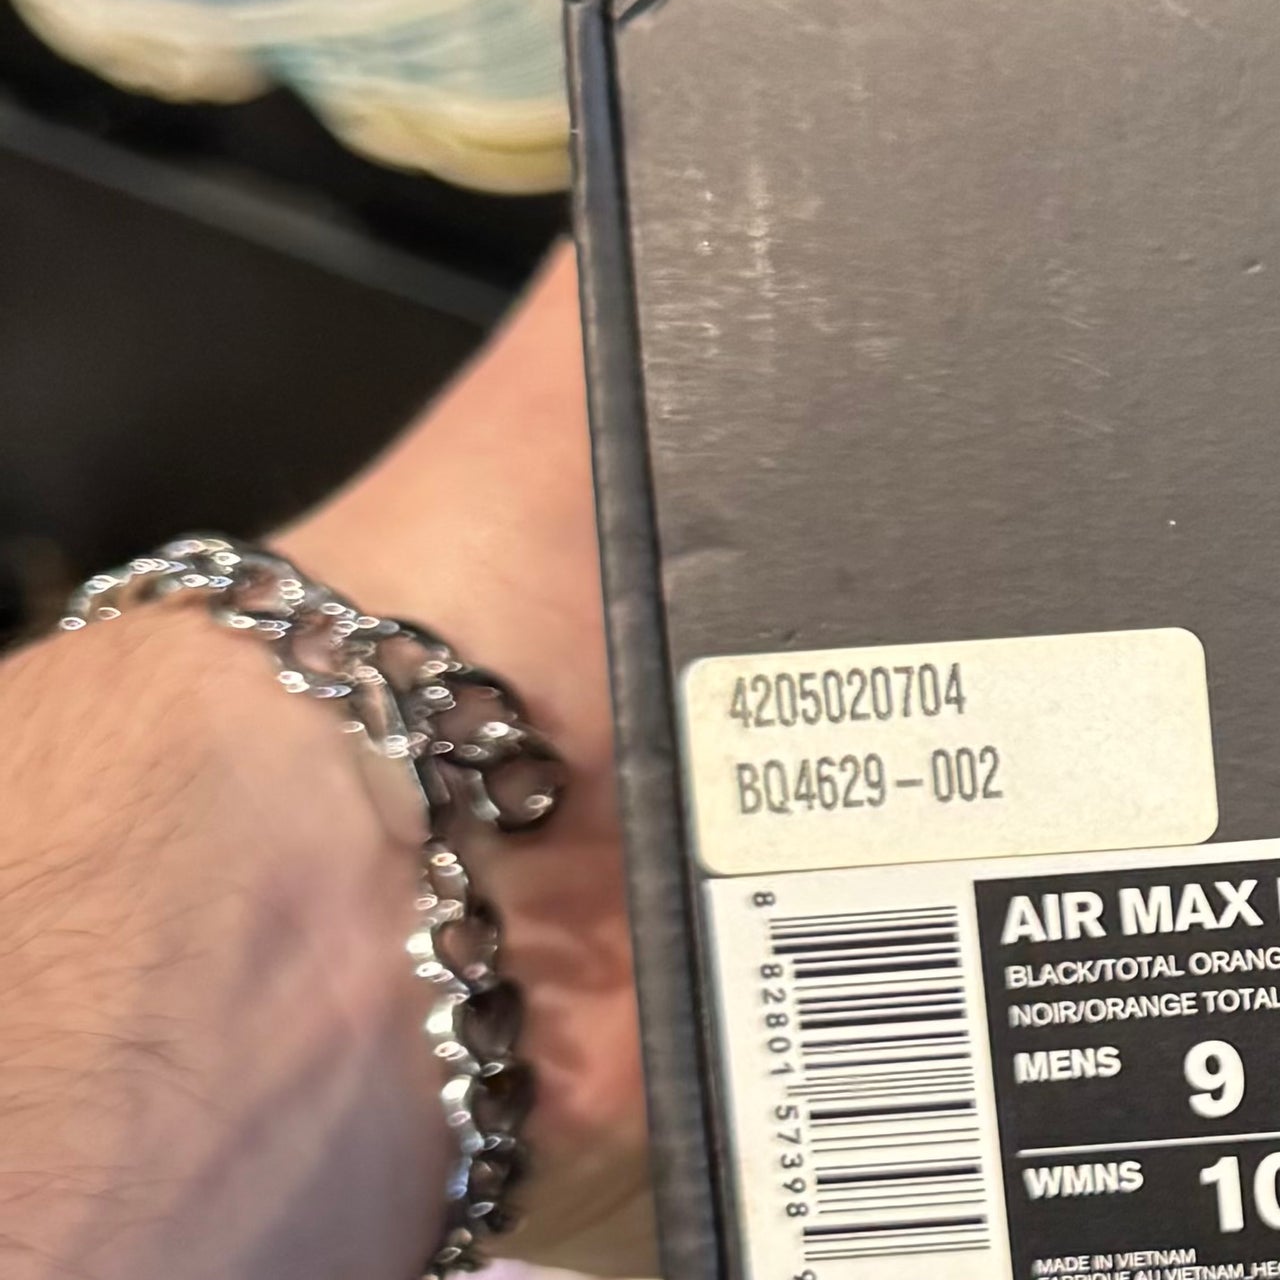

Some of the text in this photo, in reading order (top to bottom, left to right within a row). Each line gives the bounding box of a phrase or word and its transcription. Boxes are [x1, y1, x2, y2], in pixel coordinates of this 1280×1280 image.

[729, 662, 966, 728] 4205020704
[735, 745, 1003, 815] BQ4629-002
[751, 891, 776, 908] 8
[1001, 891, 1107, 945] AIR
[1118, 879, 1264, 936] MAX
[1005, 954, 1186, 989] BLACK/TOTAL
[760, 963, 795, 1075] 82801
[1009, 992, 1199, 1027] NOIR/ORANGE
[1014, 1040, 1245, 1118] MENS 9
[775, 1105, 808, 1217] 57398
[1023, 1160, 1144, 1199] WMNS
[1034, 1248, 1196, 1273] MADE IN VIETNAM
